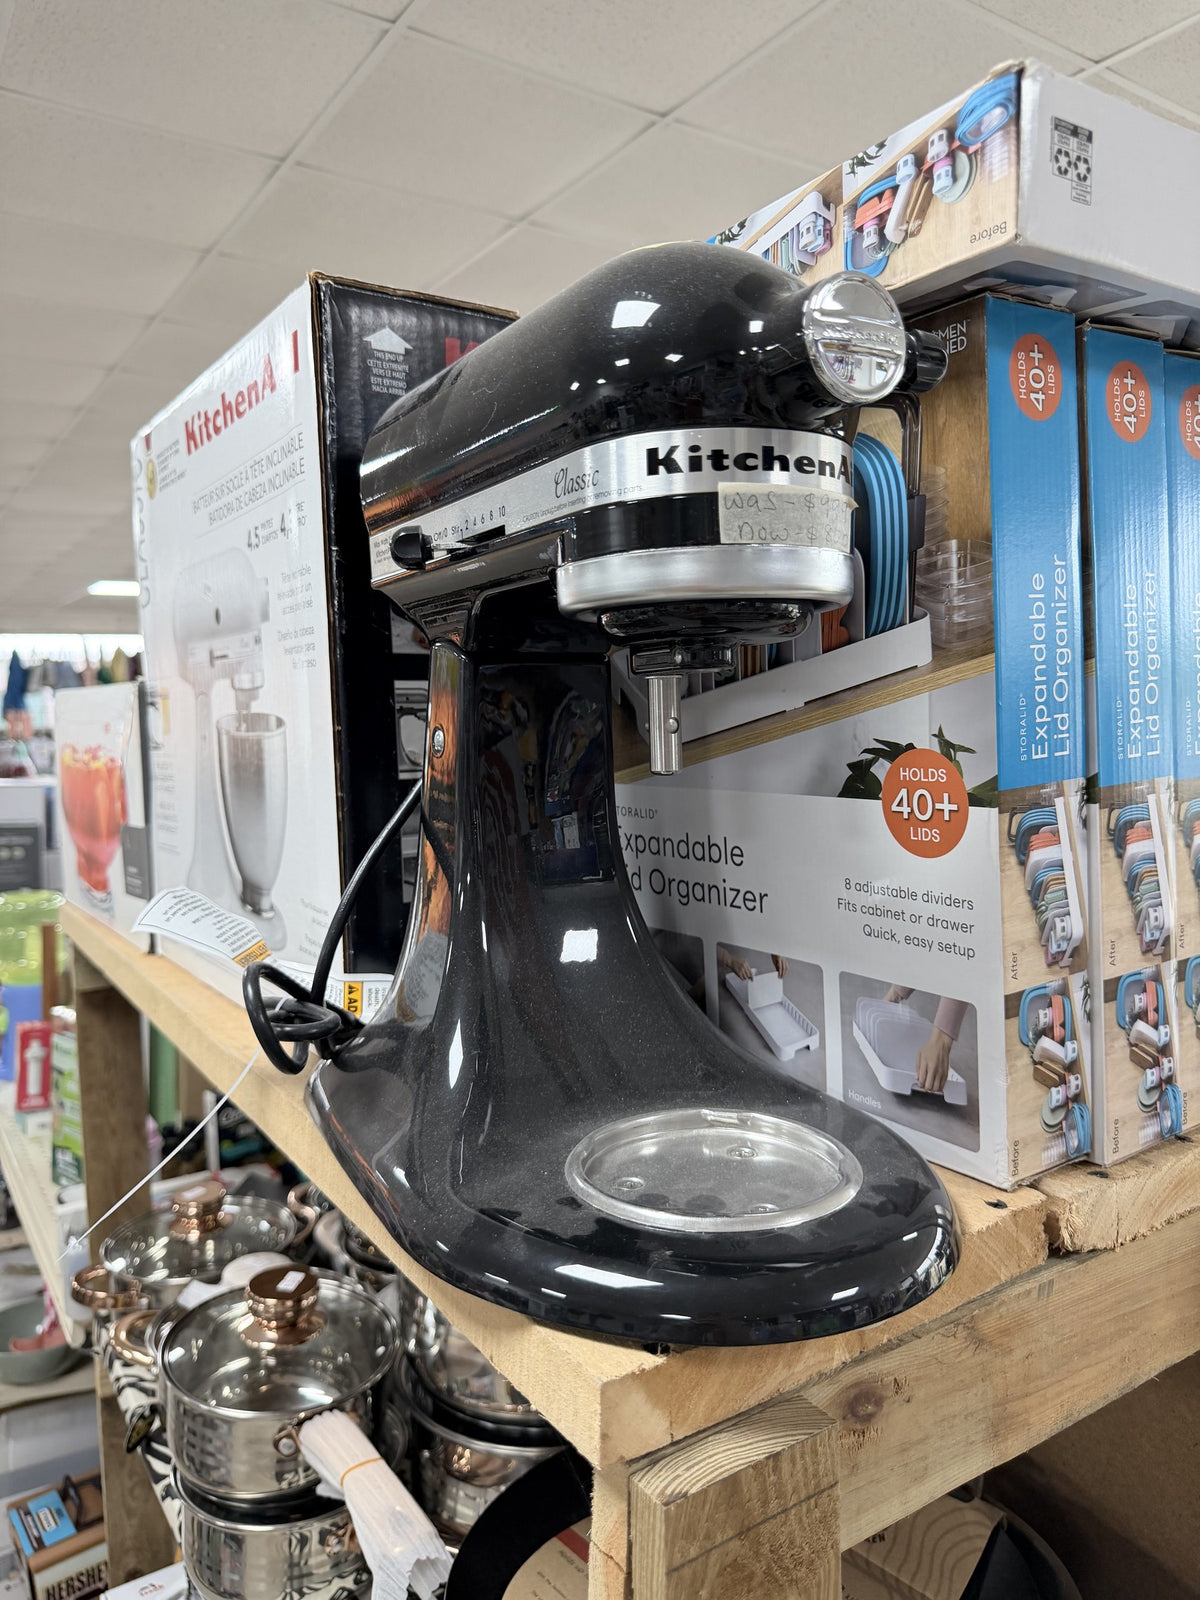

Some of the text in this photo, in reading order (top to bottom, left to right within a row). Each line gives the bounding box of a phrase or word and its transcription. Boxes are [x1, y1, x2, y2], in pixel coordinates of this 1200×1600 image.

[970, 221, 1006, 244] Before
[1018, 352, 1027, 399] HOLDS
[1029, 343, 1046, 412] 40+
[1123, 370, 1137, 434] 40+
[554, 467, 600, 499] Classic
[499, 506, 506, 518] 10
[1029, 573, 1051, 760] Expandable
[1051, 554, 1071, 757] Lid Organizer
[1124, 584, 1144, 759] Expandable
[1143, 569, 1161, 756] Lid Organizer
[900, 767, 947, 783] HOLDS
[616, 805, 656, 820] TORALID
[890, 788, 958, 822] 40+
[618, 825, 744, 867] xpandable
[910, 826, 940, 843] LIDS
[649, 868, 768, 913] Organizer
[844, 878, 974, 910] 8 adjustable dividers
[837, 898, 975, 934] Fits cabinet or drawer
[863, 924, 976, 960] Quick, easy setup
[848, 1089, 881, 1109] Handles
[1012, 1139, 1020, 1177] Before
